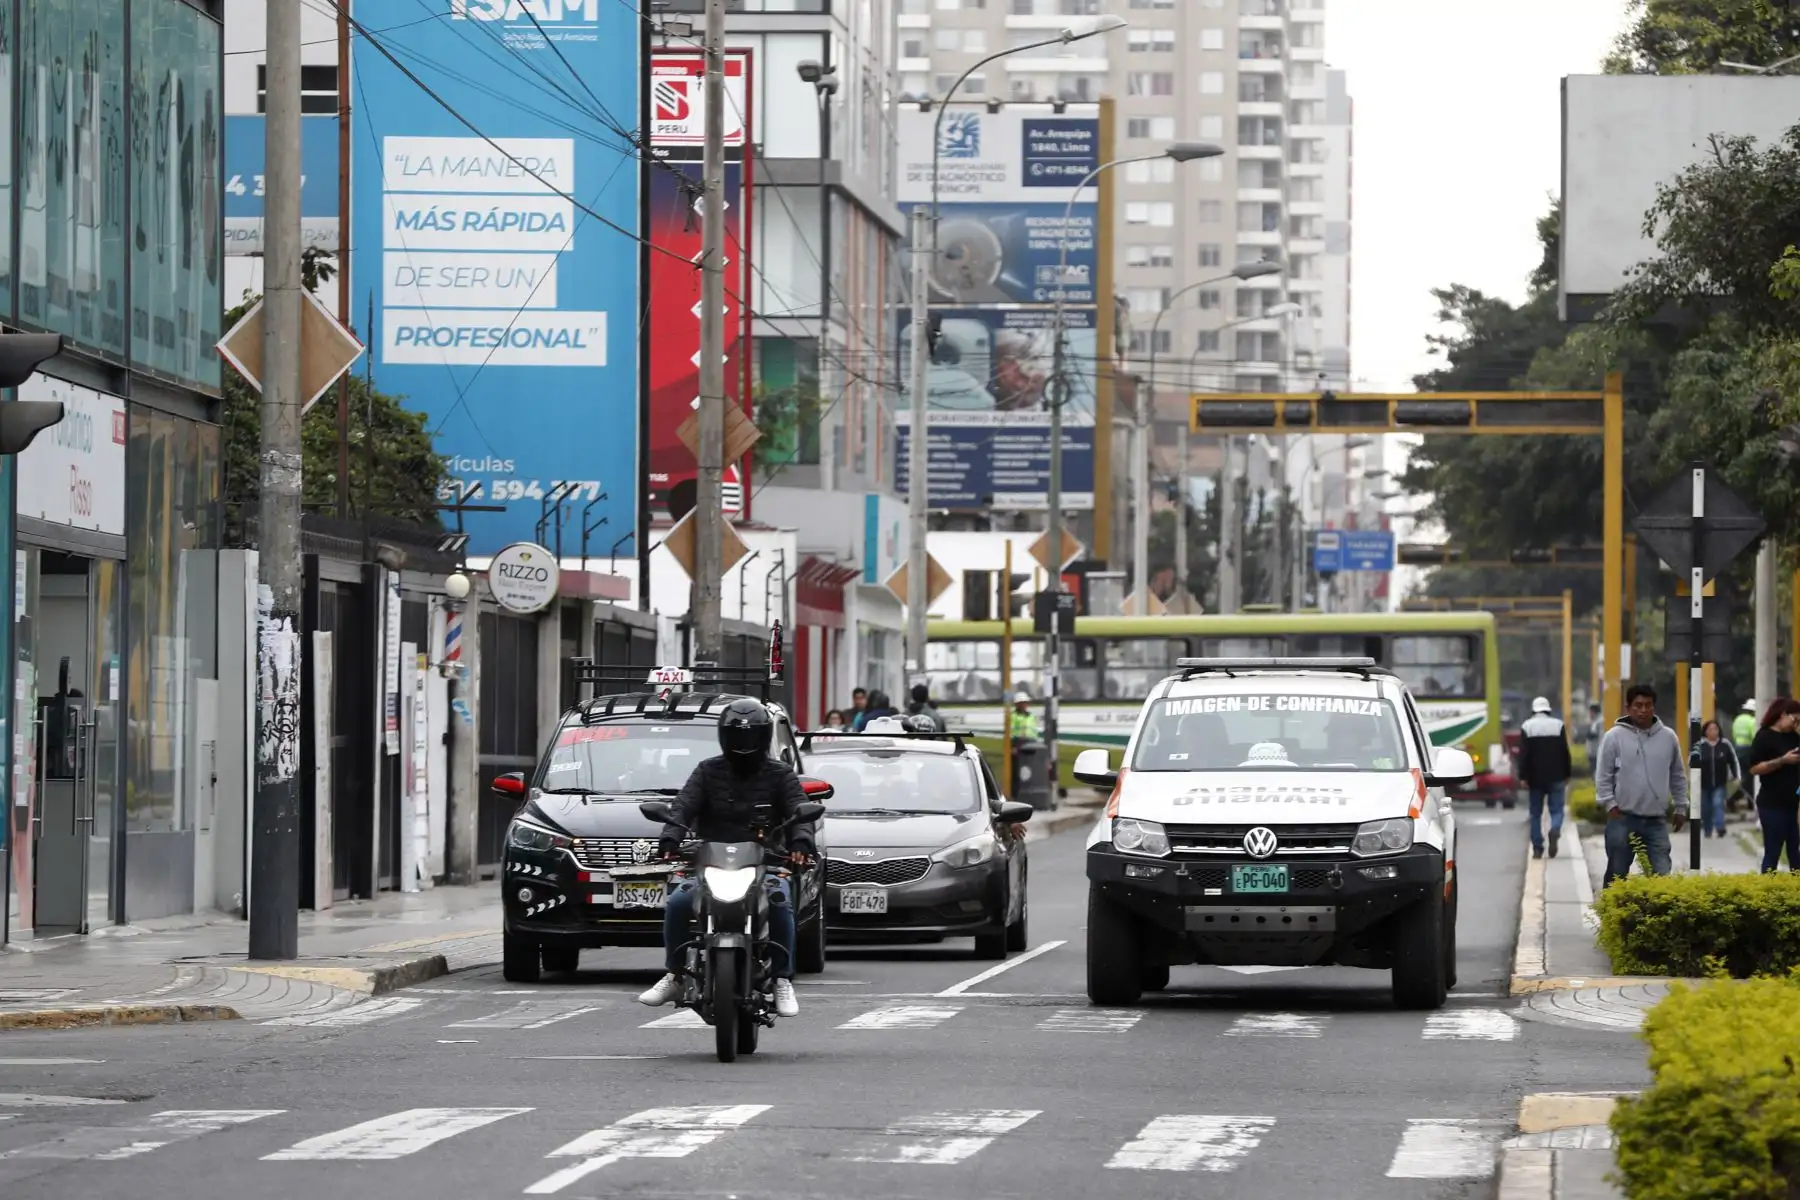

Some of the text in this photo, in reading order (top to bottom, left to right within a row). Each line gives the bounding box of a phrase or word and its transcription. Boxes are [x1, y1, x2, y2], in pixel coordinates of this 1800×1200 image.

[440, 156, 558, 178] MANERA
[395, 205, 566, 232] MÁS RÁPIDA
[395, 266, 535, 289] DE SER UN
[491, 479, 544, 501] 594
[499, 562, 549, 582] RIZZO
[655, 672, 684, 683] TAXI
[1165, 696, 1382, 717] IMAGEN DE CONFIANZA
[617, 888, 664, 903] BSS-497
